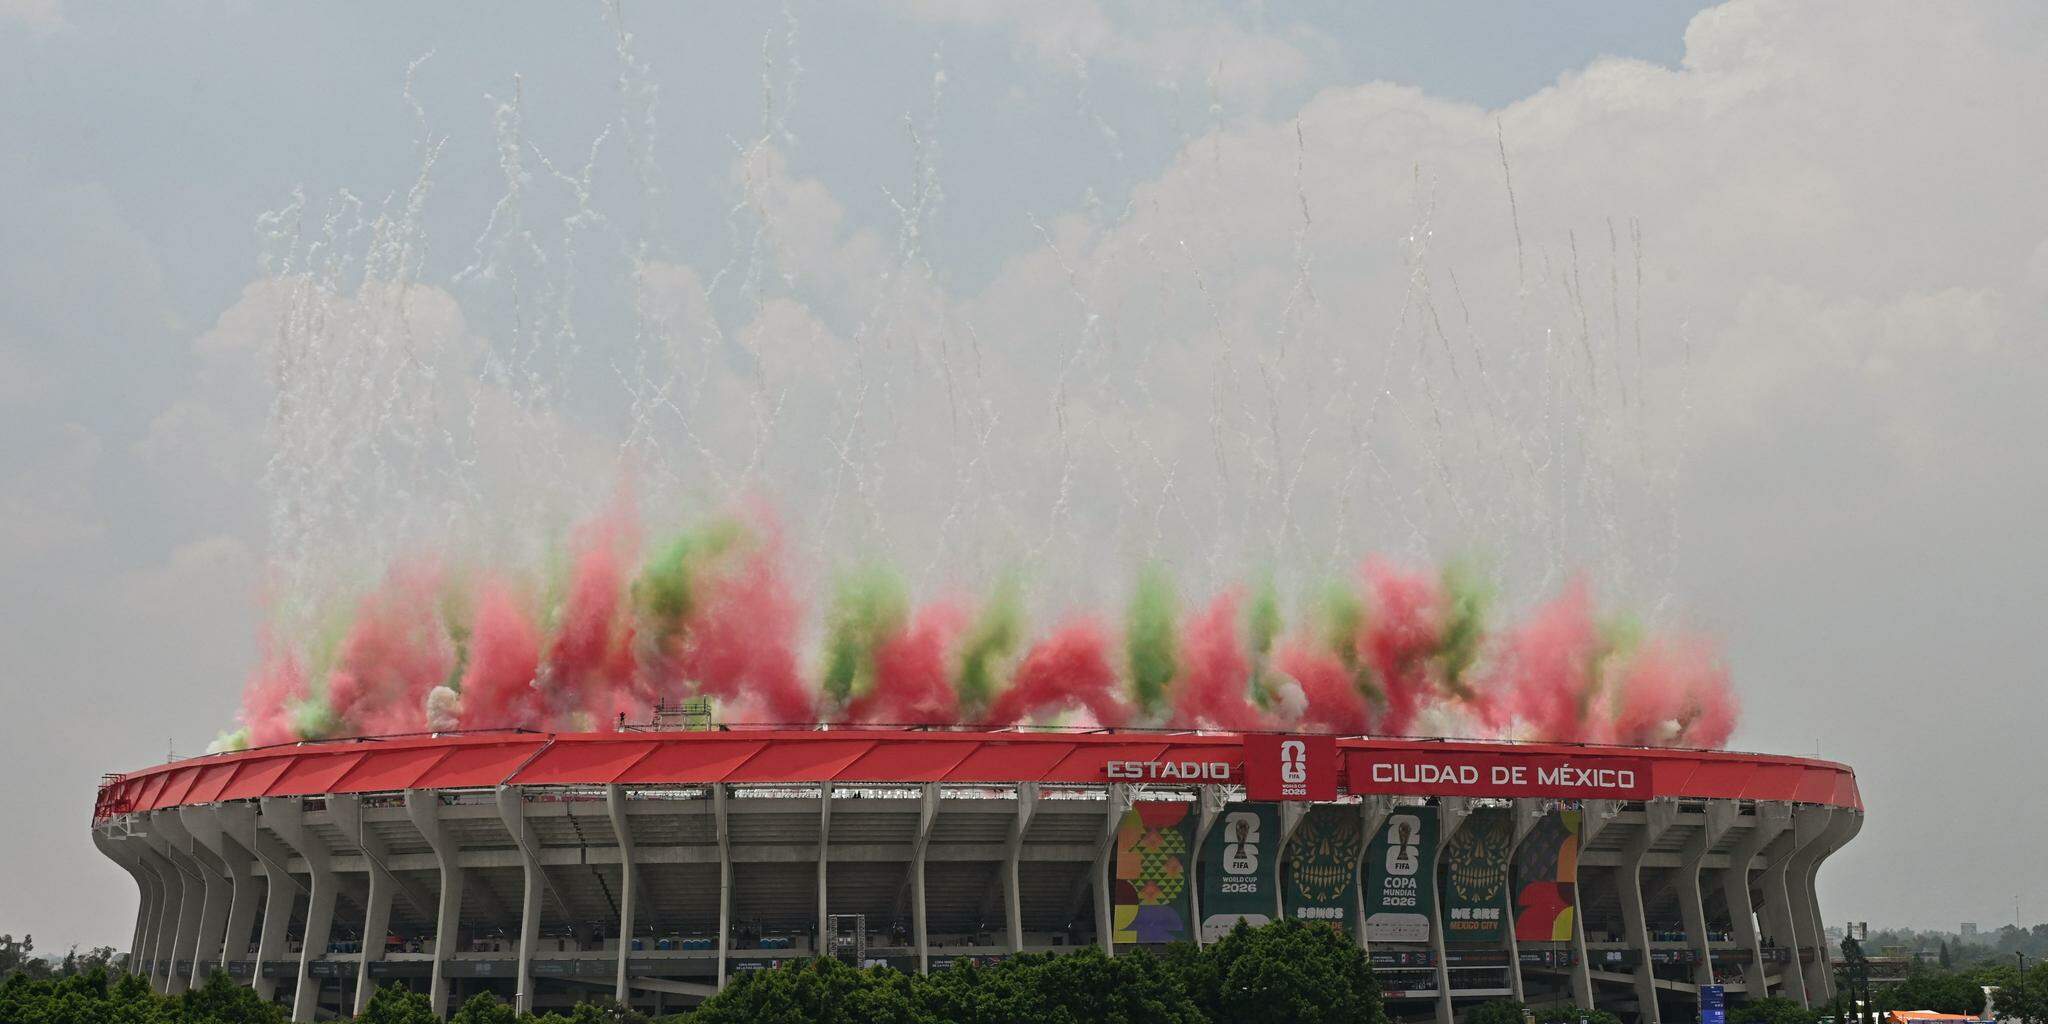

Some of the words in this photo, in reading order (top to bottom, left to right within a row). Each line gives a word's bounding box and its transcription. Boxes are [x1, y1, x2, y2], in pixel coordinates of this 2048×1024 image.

[1107, 761, 1230, 779] ESTADIO
[1372, 763, 1479, 785] CIUDAD
[1491, 766, 1527, 785] DE
[1537, 764, 1635, 788] MÉXICO
[1222, 884, 1257, 893] 2026
[1384, 877, 1417, 889] COPA
[1382, 897, 1416, 906] 2026
[1297, 907, 1344, 918] SOMOS
[1451, 908, 1471, 919] WE
[1481, 921, 1498, 930] CITY
